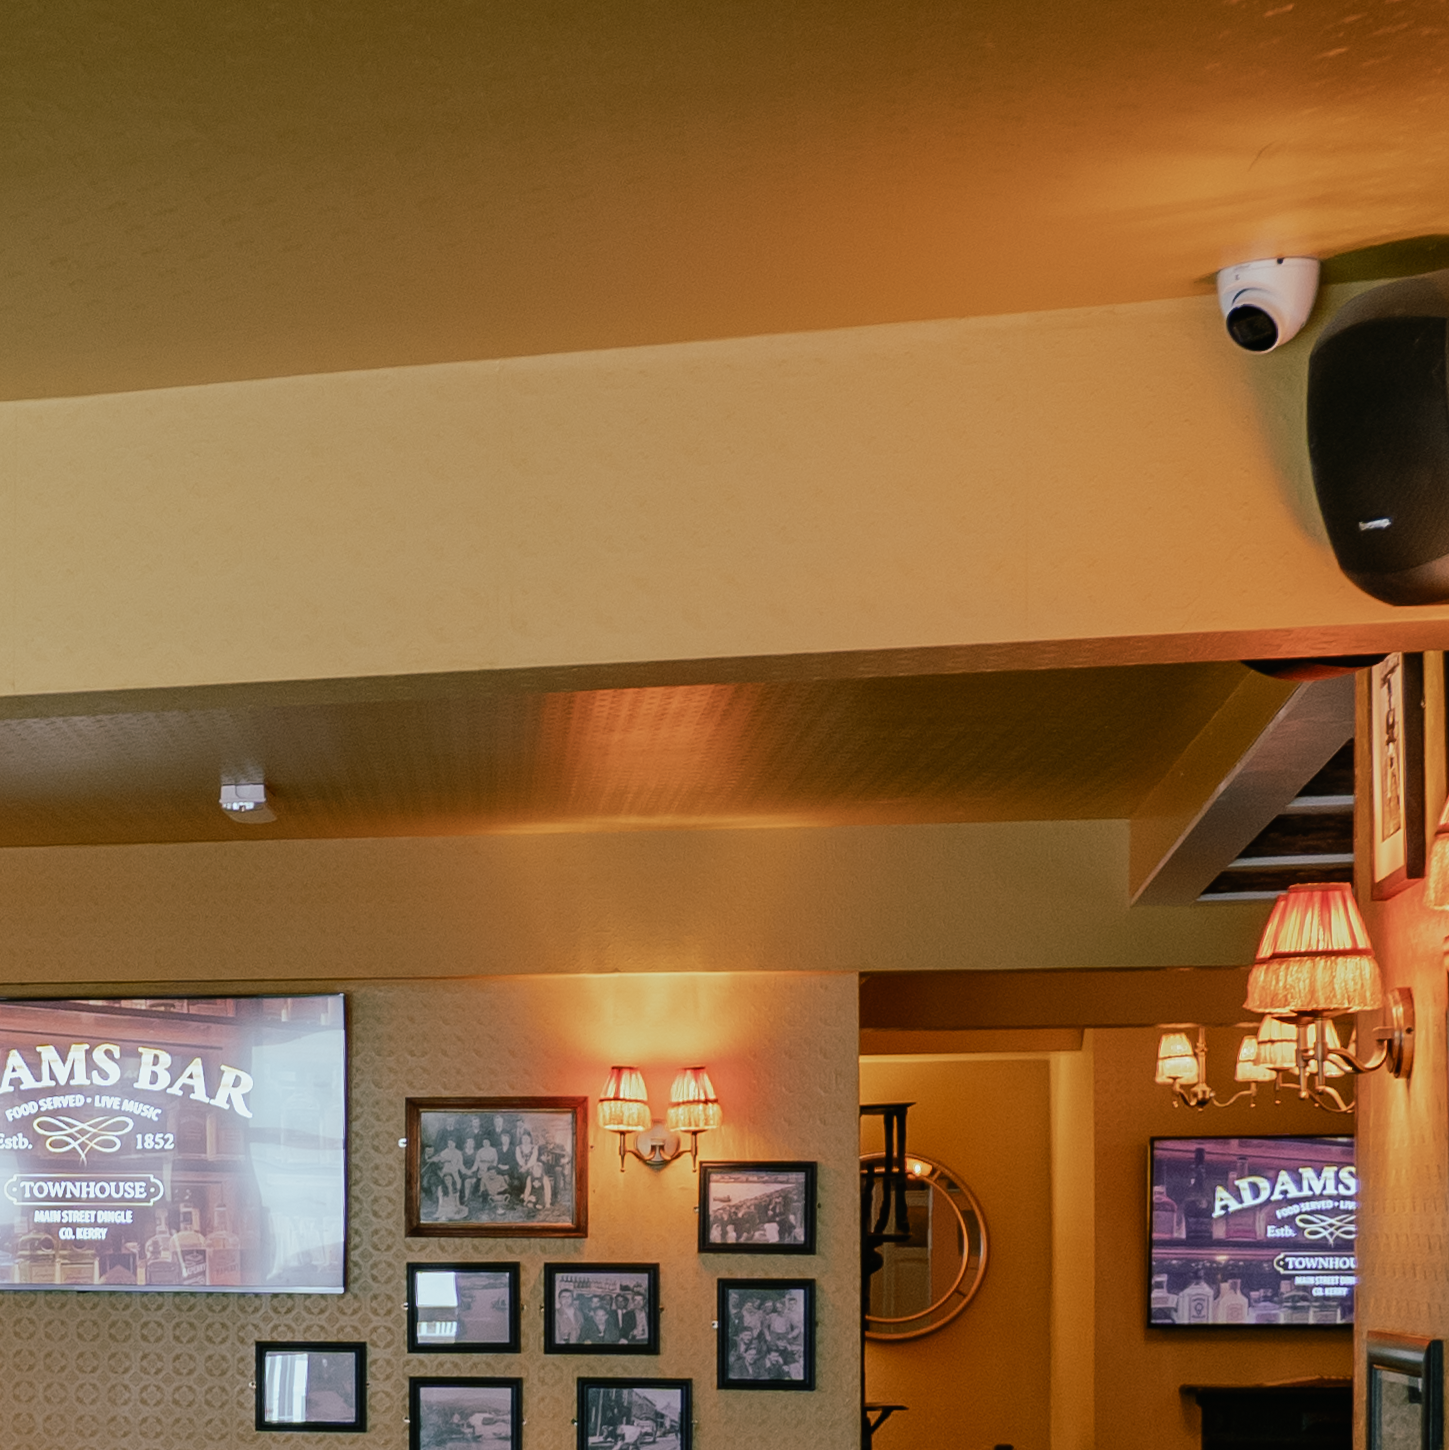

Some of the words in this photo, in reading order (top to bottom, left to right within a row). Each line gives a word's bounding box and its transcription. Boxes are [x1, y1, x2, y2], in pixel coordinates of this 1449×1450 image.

[133, 1047, 254, 1119] BAR
[5, 1101, 38, 1122] FOOD
[39, 1094, 85, 1112] SERVED
[94, 1095, 121, 1110] LIVE
[121, 1098, 162, 1122] MUSIC
[135, 1133, 175, 1150] 1852
[19, 1181, 148, 1199] TOWNHOUSE
[1212, 1165, 1356, 1219] ADAMS
[34, 1210, 62, 1223] MAIN
[62, 1210, 96, 1223] STREET
[97, 1210, 134, 1224] DINGLE
[58, 1227, 75, 1240] CO.
[76, 1227, 109, 1241] KERRY
